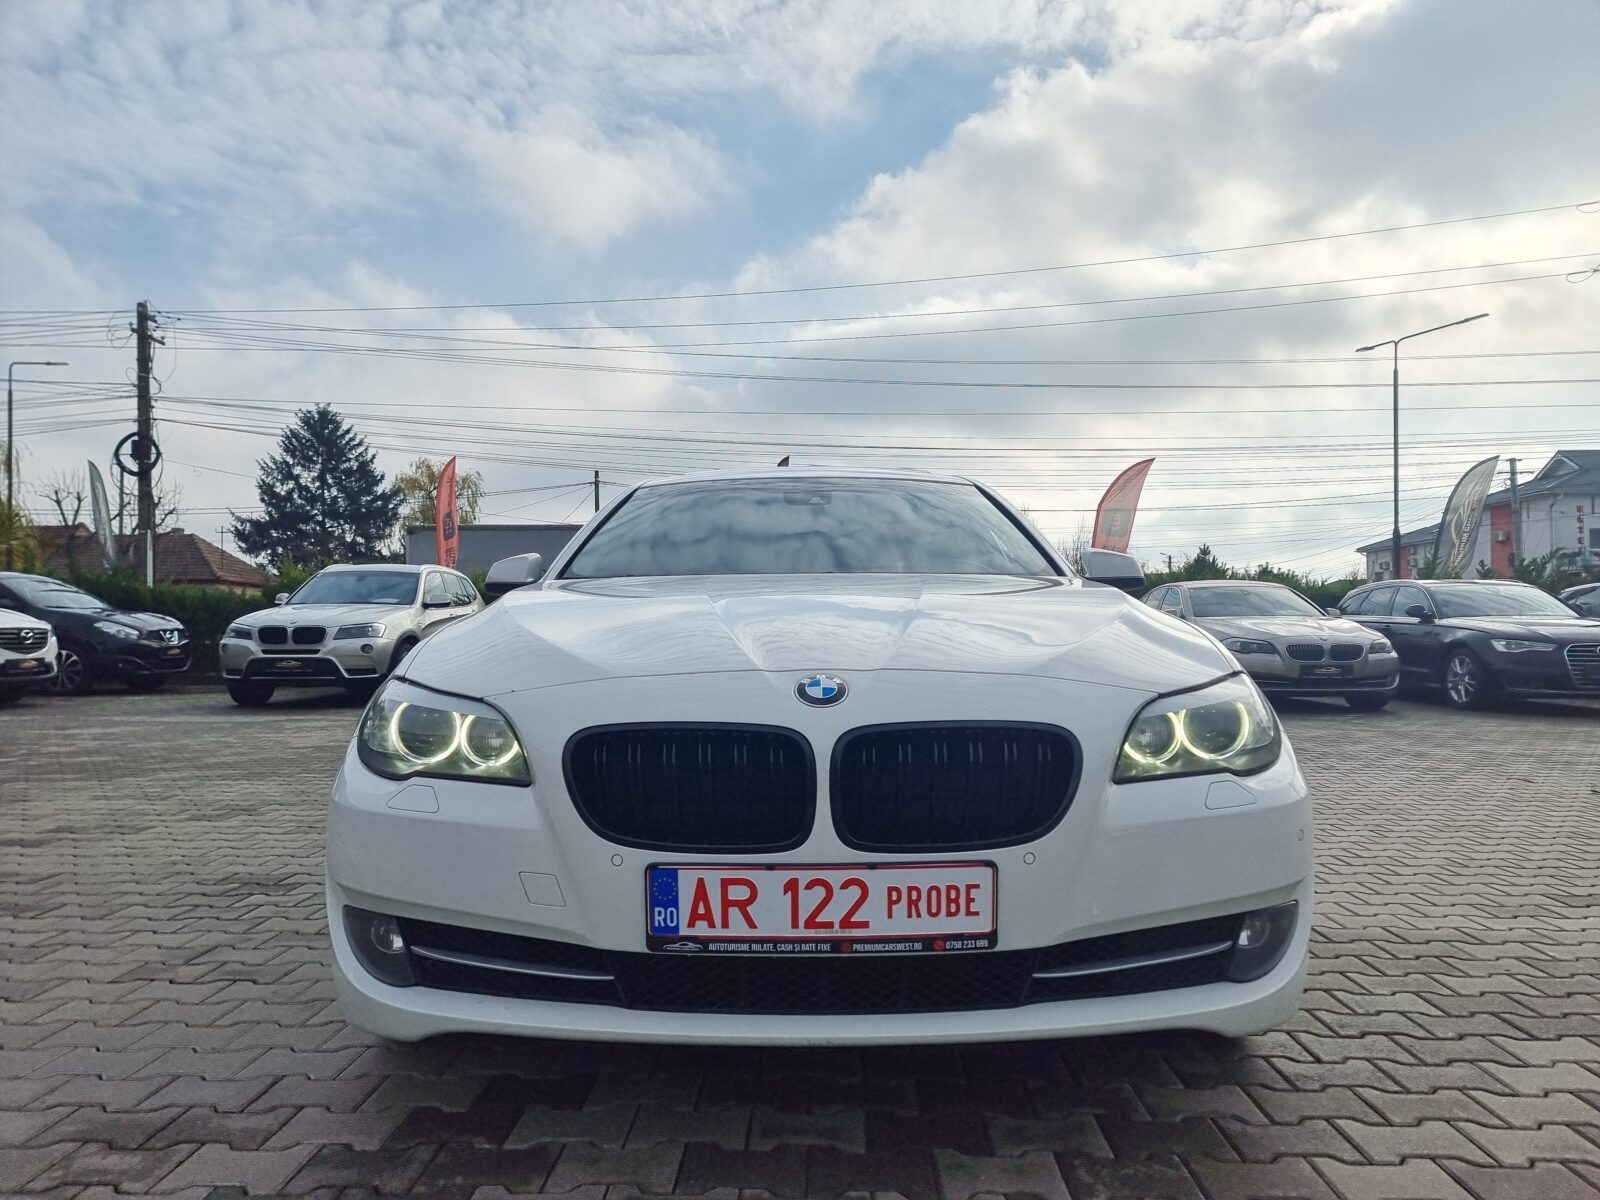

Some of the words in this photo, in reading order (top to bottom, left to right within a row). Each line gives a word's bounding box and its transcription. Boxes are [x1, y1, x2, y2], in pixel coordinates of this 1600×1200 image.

[686, 877, 759, 930] AR
[783, 876, 871, 930] 122
[886, 883, 982, 919] PROBE
[653, 907, 678, 928] RO
[708, 943, 750, 951] AUTOTURISME
[777, 943, 793, 951] CASH
[801, 943, 817, 951] RATE
[817, 943, 832, 951] FIXE
